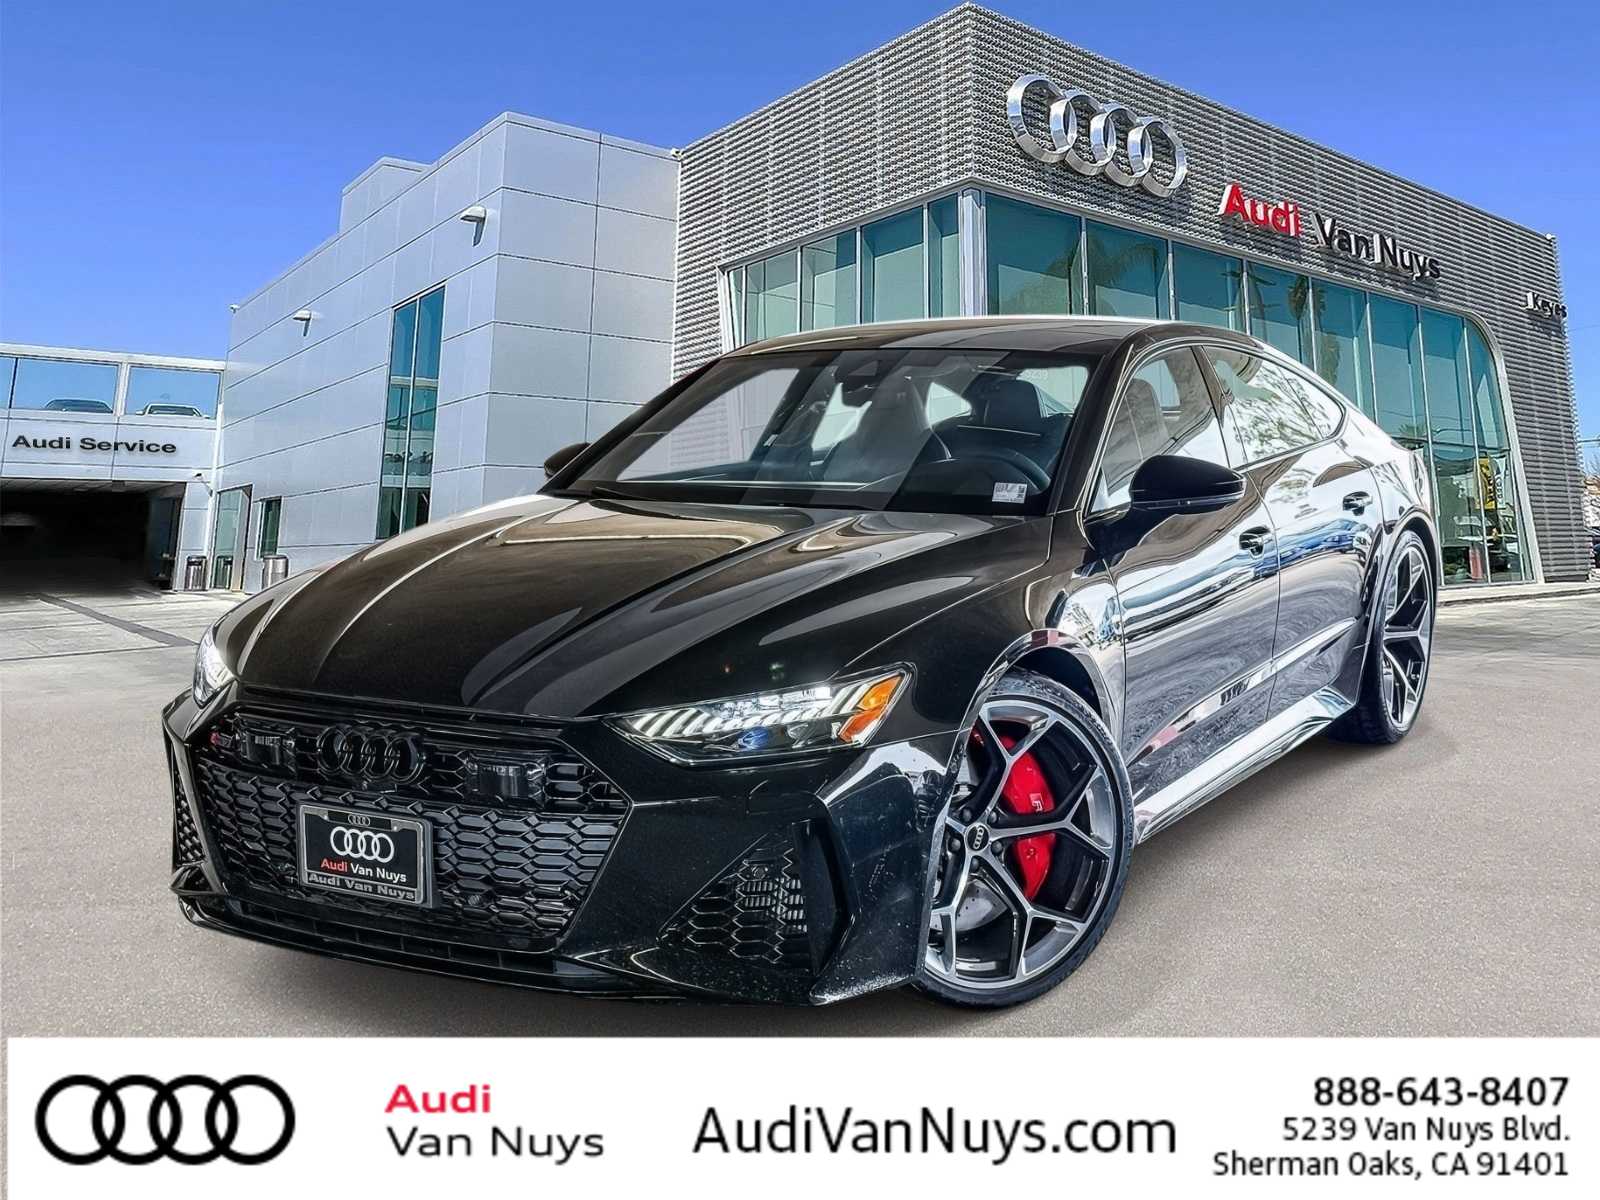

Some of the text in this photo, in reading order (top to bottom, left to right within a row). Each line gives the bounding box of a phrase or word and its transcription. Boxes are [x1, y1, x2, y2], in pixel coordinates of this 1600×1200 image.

[1217, 183, 1442, 280] Audi Van Nuys
[1526, 292, 1568, 319] Keyes
[12, 435, 177, 454] Audi Service
[320, 858, 407, 883] Audi Van Nuys
[308, 872, 415, 900] Audi Van Nuys
